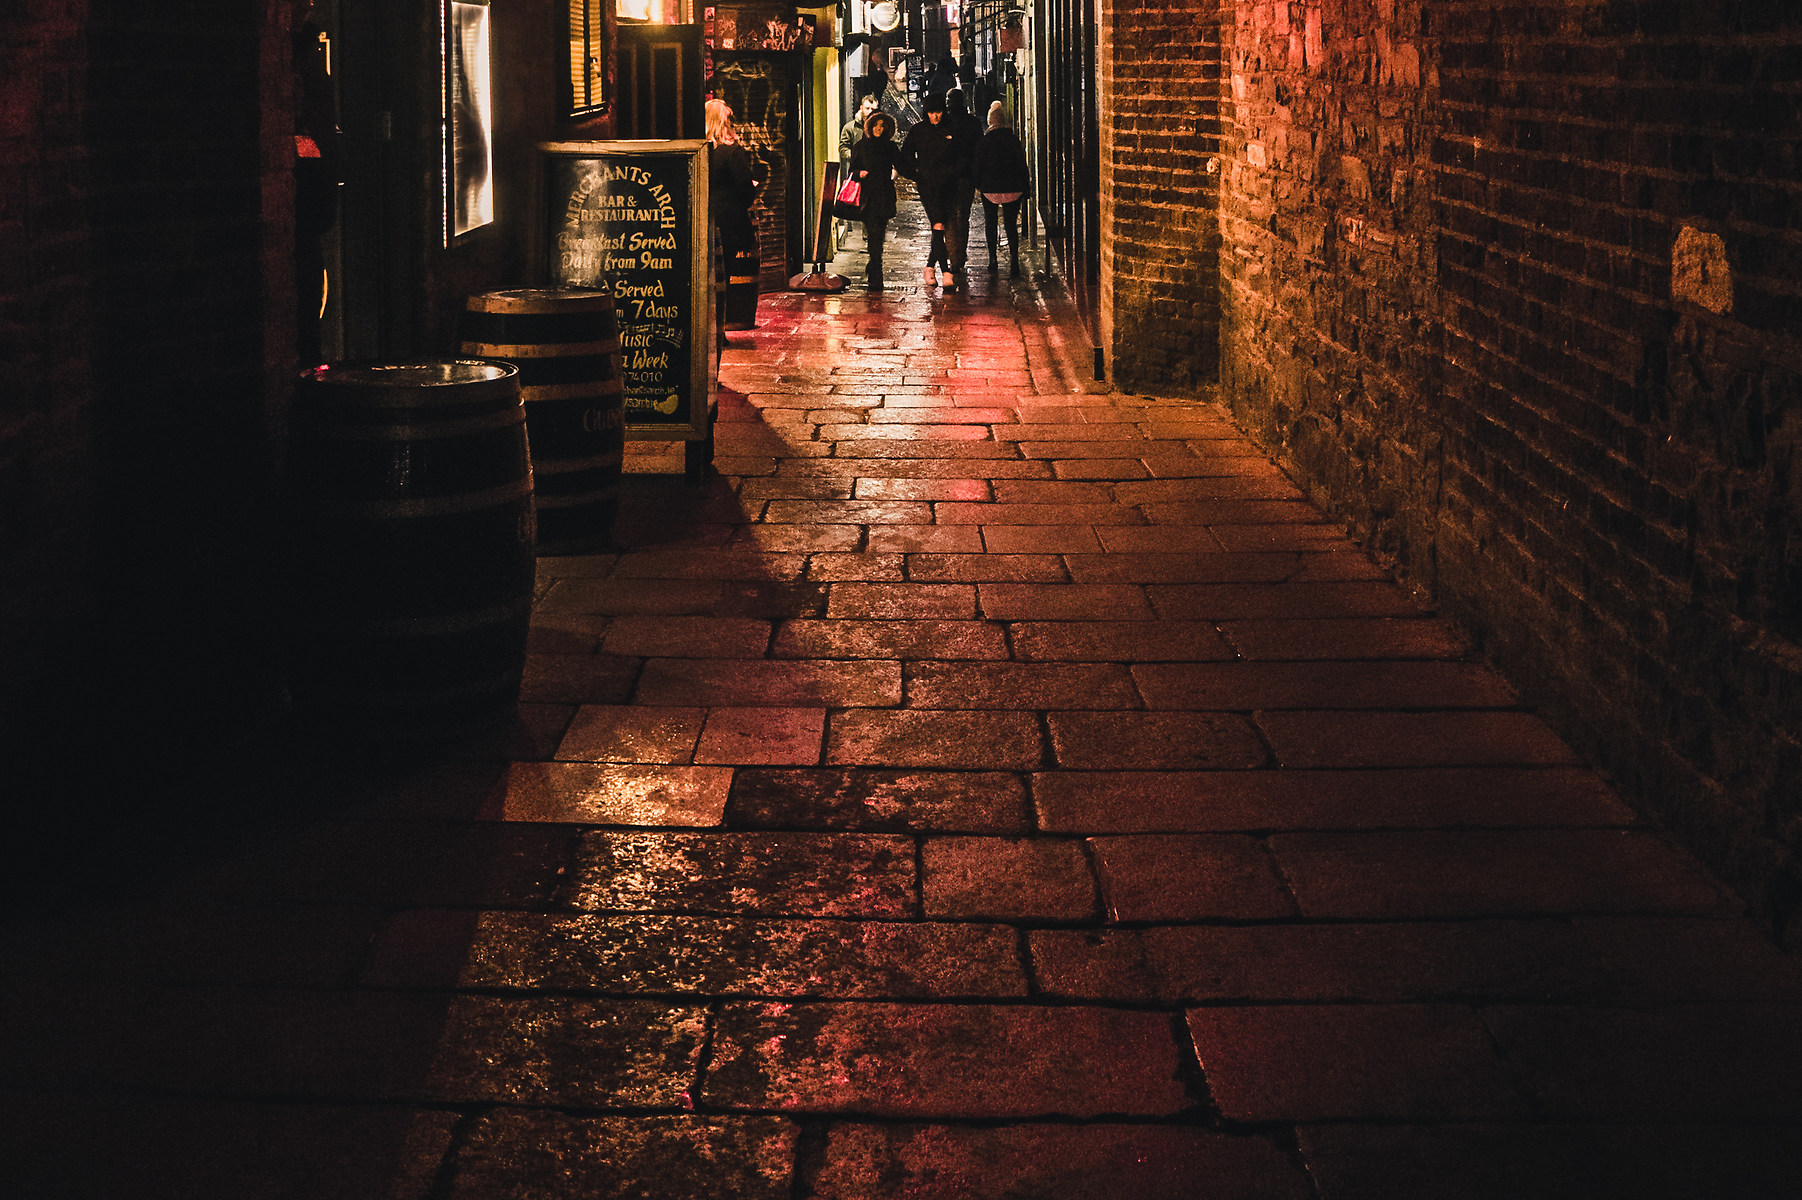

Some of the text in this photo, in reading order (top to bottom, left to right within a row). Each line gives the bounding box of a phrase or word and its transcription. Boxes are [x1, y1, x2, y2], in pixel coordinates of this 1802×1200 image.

[598, 195, 638, 207] BAR &
[648, 184, 676, 229] ARCH
[581, 209, 661, 221] RESTAURANT
[628, 232, 677, 251] Served
[604, 251, 636, 271] from
[640, 251, 673, 270] 9am
[614, 279, 664, 299] Served
[631, 300, 645, 319] 7
[645, 301, 679, 324] days
[632, 349, 669, 369] Week
